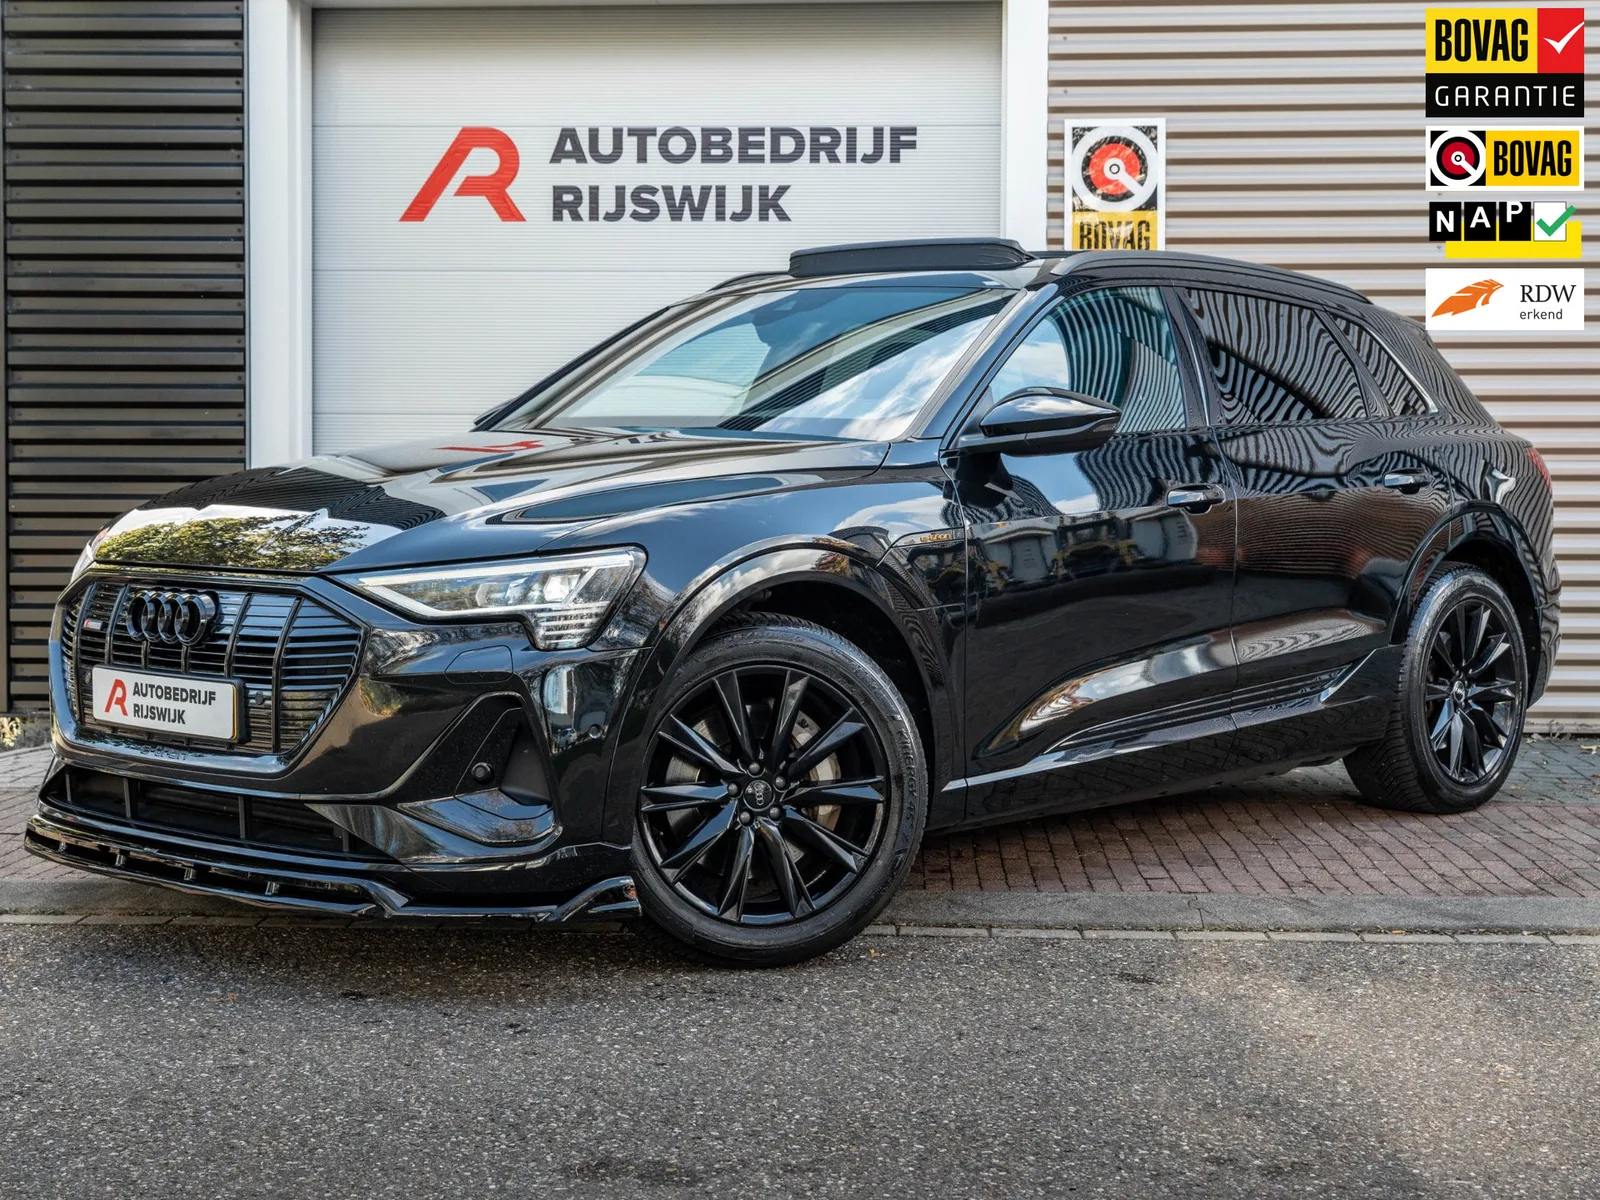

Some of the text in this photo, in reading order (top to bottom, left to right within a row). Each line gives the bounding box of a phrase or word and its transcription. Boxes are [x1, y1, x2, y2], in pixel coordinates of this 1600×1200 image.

[549, 126, 918, 164] AUTOBEDRIJF
[552, 185, 792, 222] RIJSWIJK
[1080, 220, 1150, 250] BOVAG
[132, 682, 216, 706] AUTOBEDRIJF
[133, 703, 186, 725] RIJSWIJK
